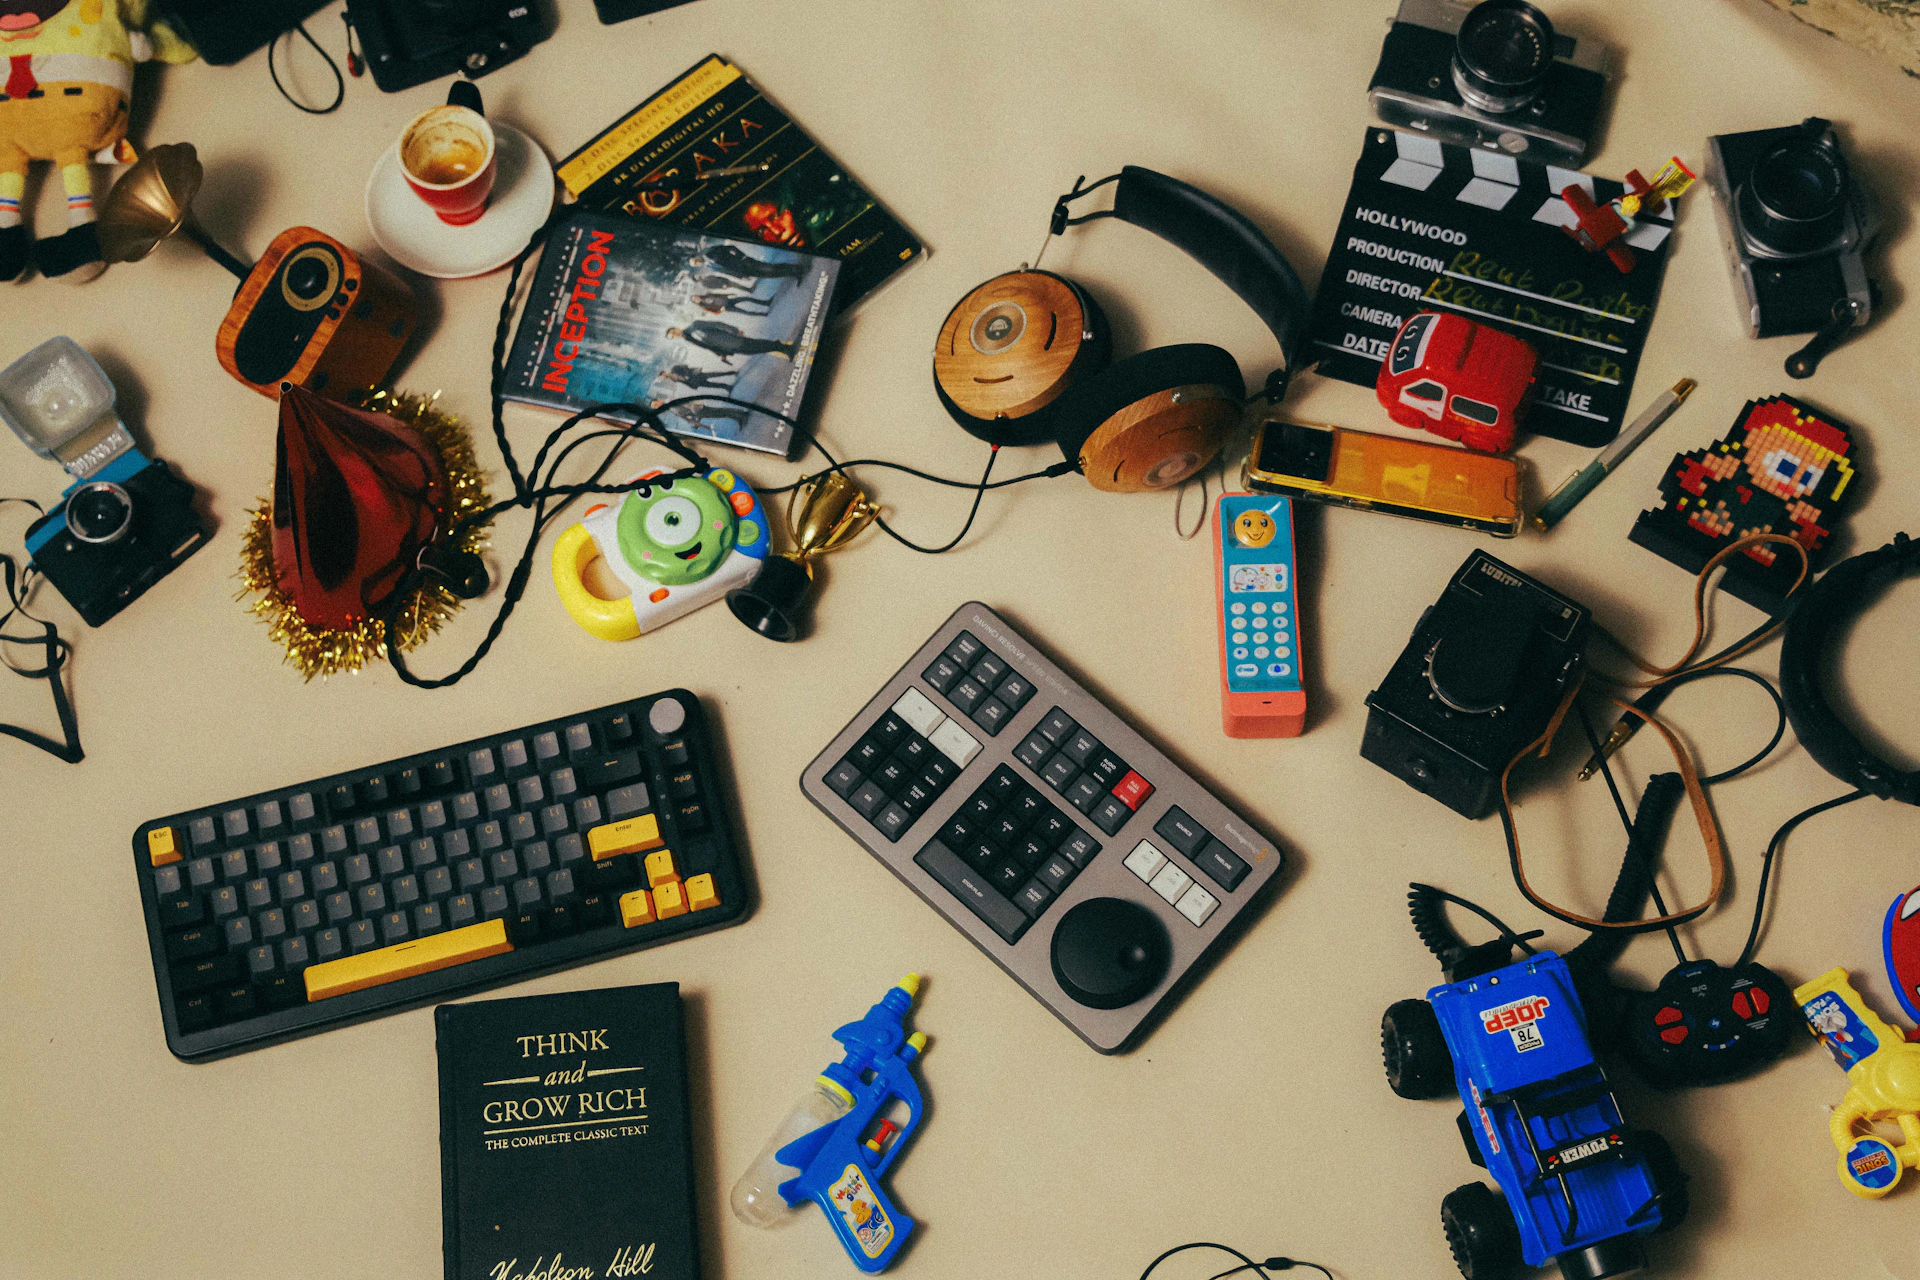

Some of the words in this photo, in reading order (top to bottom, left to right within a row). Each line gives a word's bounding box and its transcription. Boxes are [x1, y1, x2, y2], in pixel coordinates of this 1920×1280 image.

[1355, 206, 1467, 246] HOLLYWOOD
[1347, 237, 1444, 273] PRODUCTION
[1345, 269, 1422, 301] DIRECTOR
[542, 230, 615, 393] INCEPTION
[1340, 302, 1402, 329] CAMERA
[1342, 332, 1391, 358] DATE
[1544, 386, 1592, 411] TAKE
[971, 614, 998, 638] DAVINCI
[996, 634, 1025, 660] RESOLVE
[612, 716, 624, 724] Del
[932, 763, 944, 774] ROLL
[1099, 761, 1113, 773] LEVEL
[1102, 757, 1116, 770] AUDIO
[673, 773, 692, 783] PgUp
[838, 772, 848, 781] CUT
[999, 775, 1011, 786] CAM
[977, 799, 988, 810] CAM
[1024, 796, 1036, 807] CAM
[681, 804, 699, 815] PgDn
[614, 823, 632, 831] Enter
[954, 824, 965, 834] CAM
[1002, 820, 1013, 831] CAM
[1049, 818, 1060, 828] CAM
[1175, 821, 1192, 837] SOURCE
[979, 845, 990, 855] CAM
[1027, 842, 1038, 852] CAM
[596, 860, 612, 869] Shift
[1213, 853, 1232, 870] TIMELINE
[1004, 866, 1015, 877] CAM
[1025, 891, 1038, 902] ONLY
[1027, 887, 1042, 900] AUDIO
[175, 900, 189, 908] Tab
[519, 915, 530, 923] Alt
[182, 931, 201, 941] Caps
[231, 989, 245, 997] Win
[1486, 998, 1550, 1034] JOEP
[1517, 1028, 1535, 1043] 78
[516, 1028, 610, 1058] THINK
[544, 1060, 587, 1086] and
[483, 1094, 571, 1124] GROW
[578, 1087, 648, 1115] RICH
[485, 1138, 509, 1150] THE
[511, 1132, 571, 1148] COMPLETE
[573, 1127, 618, 1142] CLASSIC
[619, 1124, 649, 1137] TEXT
[1559, 1138, 1610, 1164] POWER
[1854, 1155, 1889, 1174] SONIC
[847, 1182, 863, 1202] gun
[489, 1252, 595, 1280] Napoleon
[606, 1243, 656, 1278] Hill
